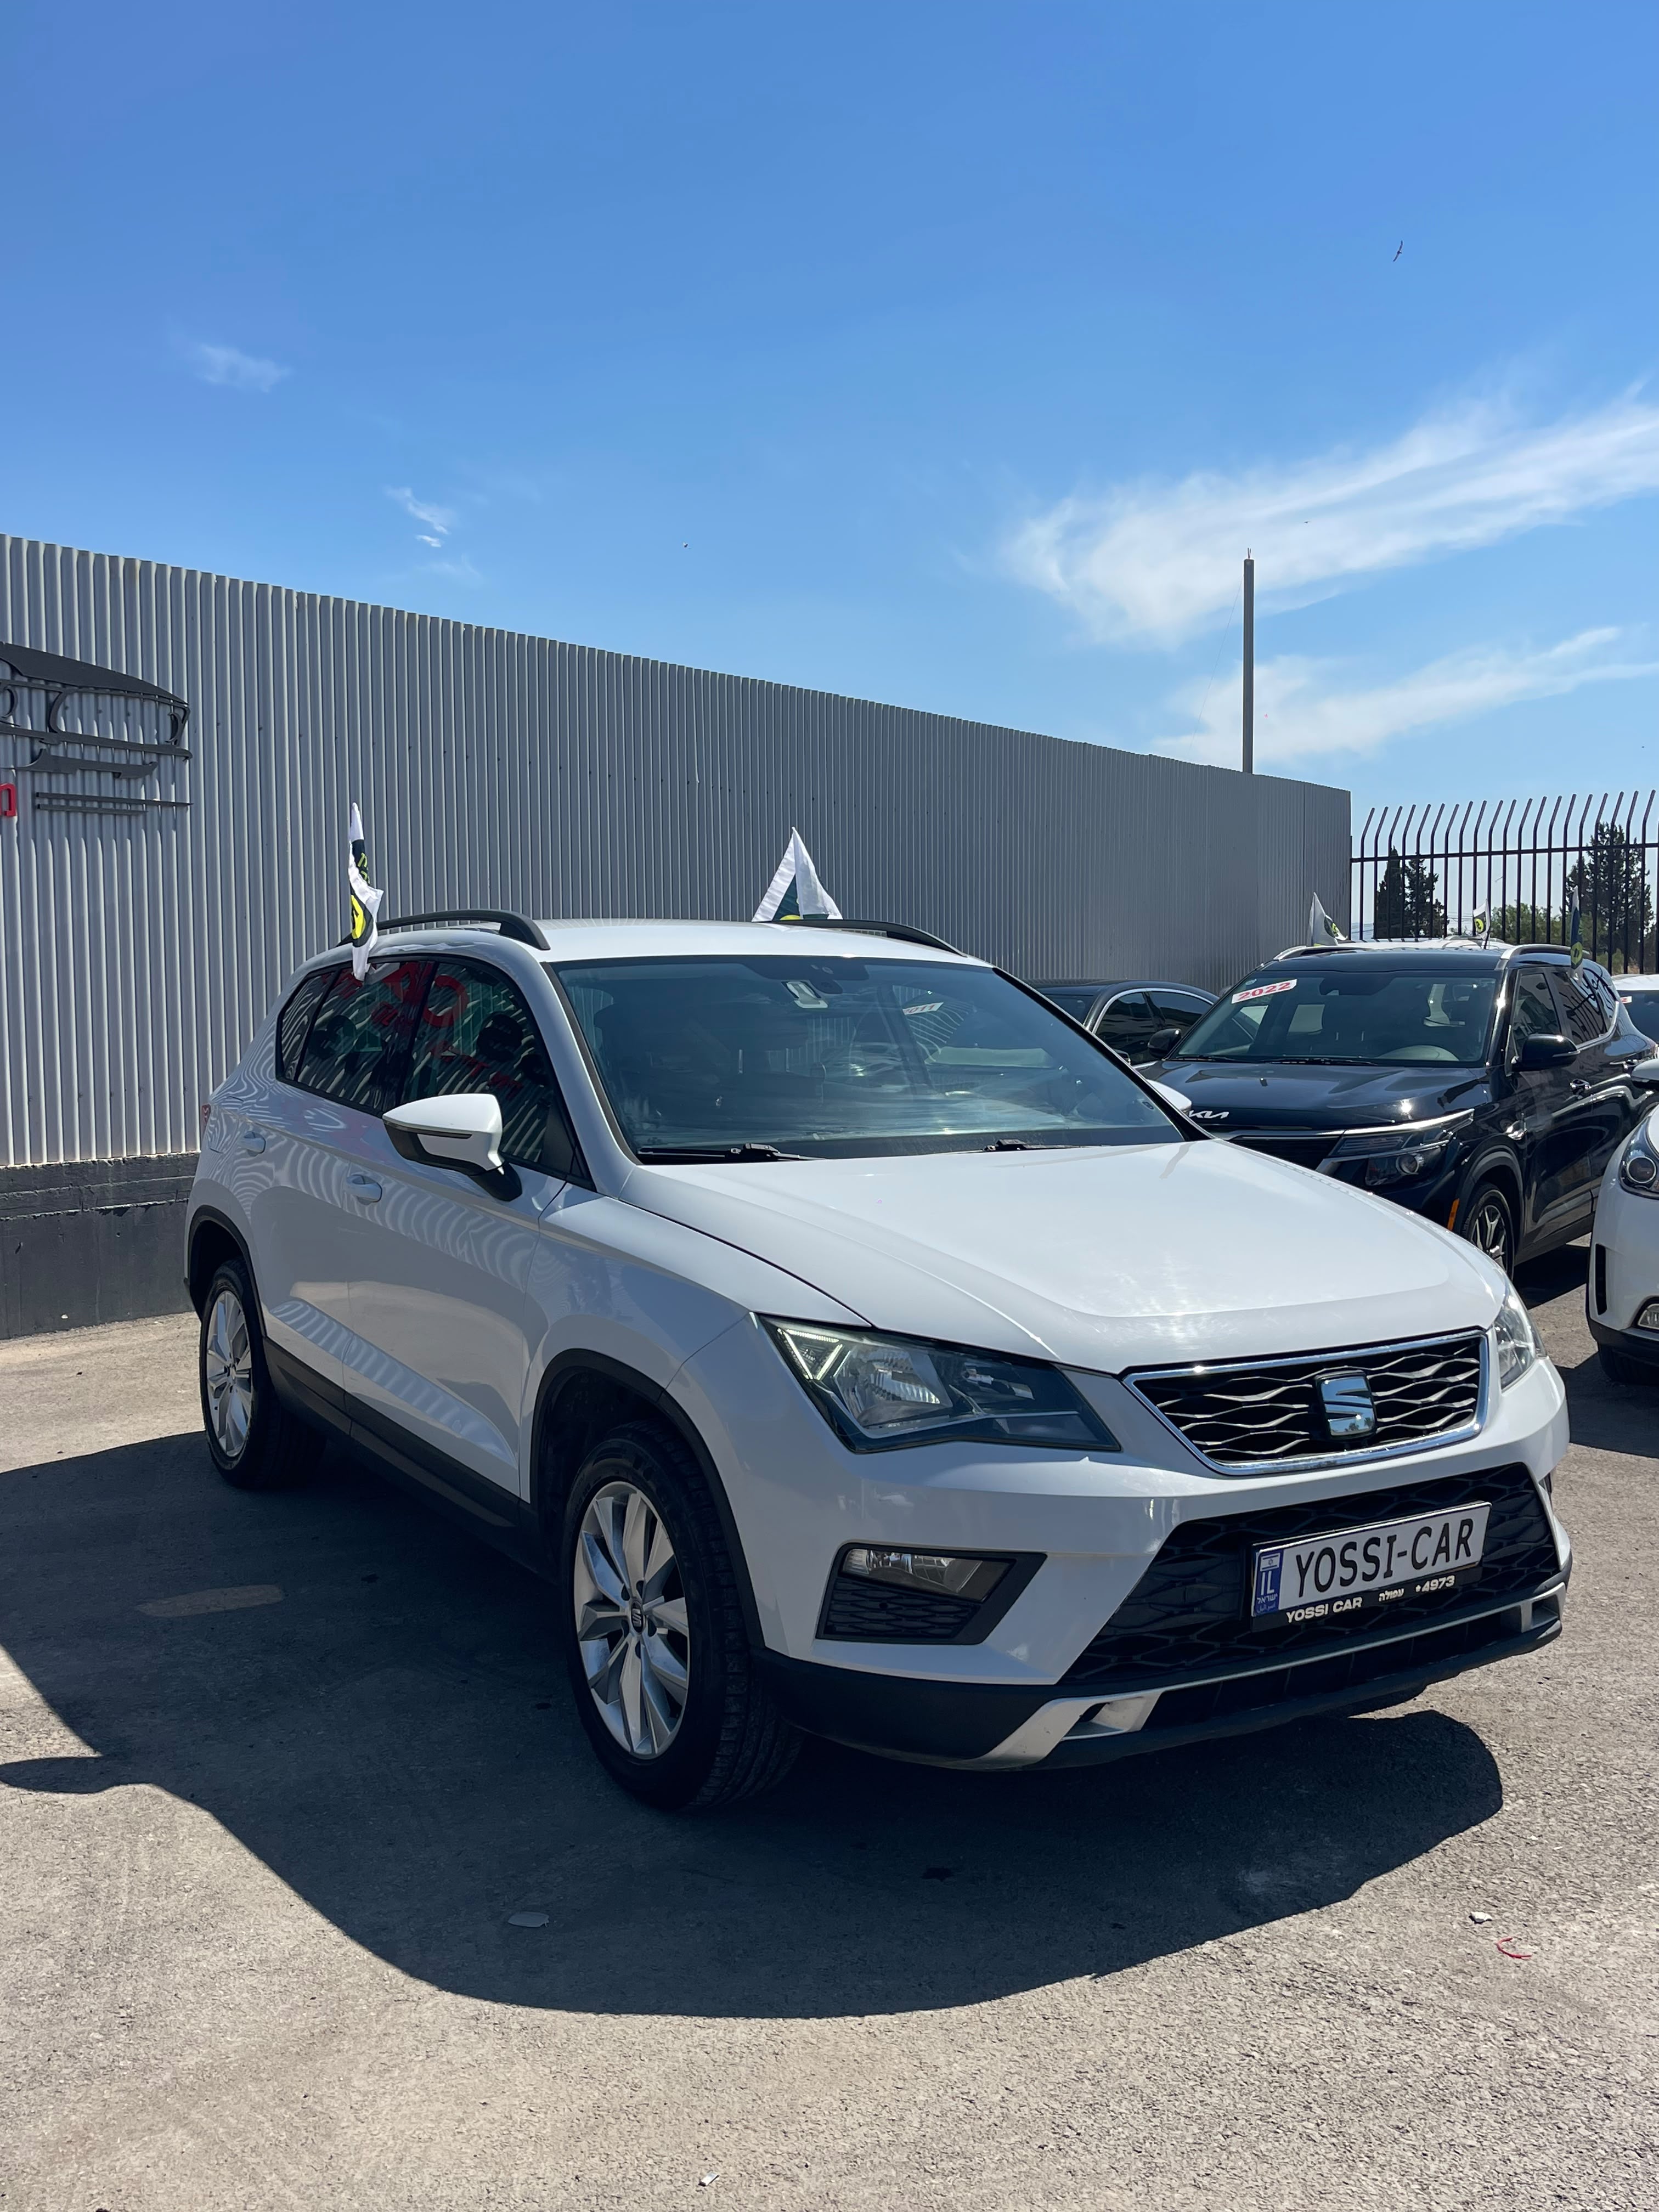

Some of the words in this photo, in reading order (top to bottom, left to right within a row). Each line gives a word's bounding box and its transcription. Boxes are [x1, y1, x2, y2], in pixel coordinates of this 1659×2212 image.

[1238, 982, 1290, 1001] 2022
[1295, 1518, 1474, 1598] YOSSI-CAR
[1261, 1570, 1274, 1596] IL
[1257, 1593, 1278, 1604] ישראל
[1378, 1588, 1404, 1602] עפולה
[1286, 1604, 1328, 1623] YOSSI
[1333, 1597, 1363, 1613] CAR
